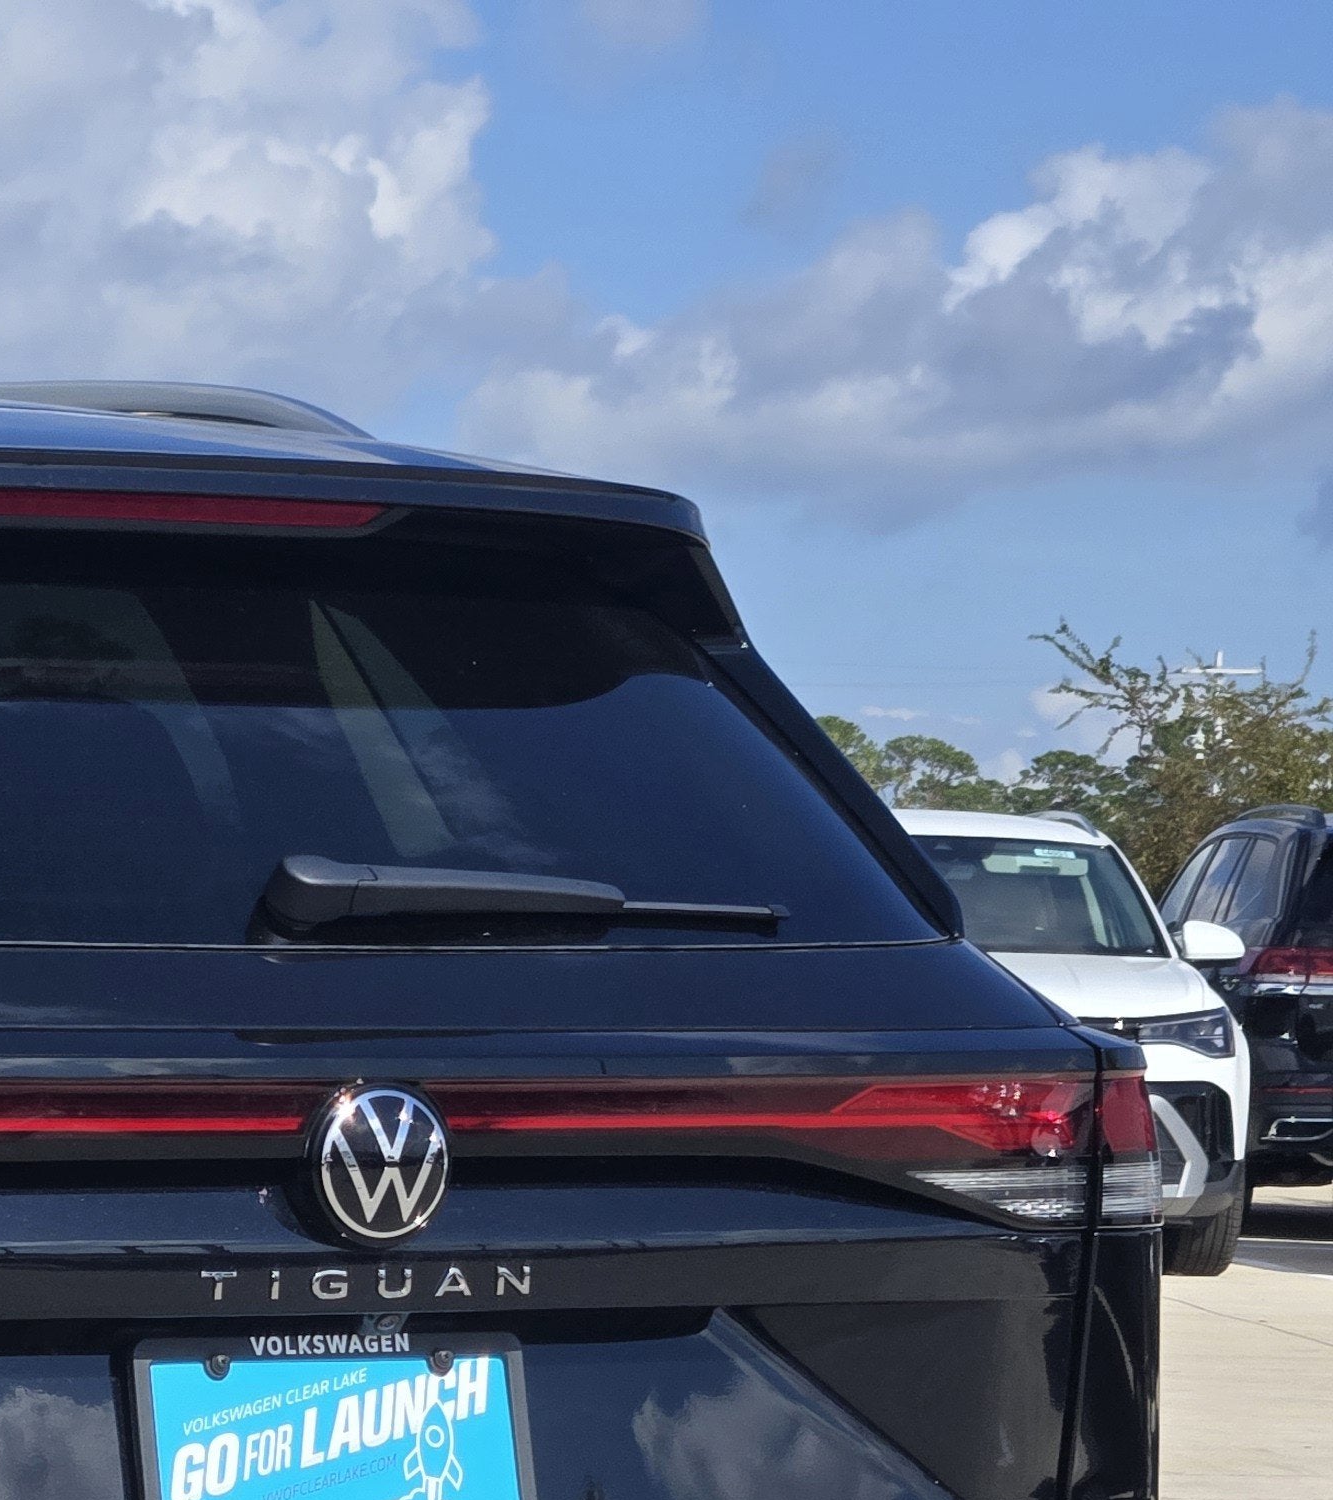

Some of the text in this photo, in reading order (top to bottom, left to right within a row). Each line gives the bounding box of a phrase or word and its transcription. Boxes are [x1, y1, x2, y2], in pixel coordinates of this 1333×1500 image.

[325, 1090, 446, 1232] VW
[200, 1265, 531, 1301] TIGUAN
[250, 1333, 410, 1356] VOLKSWAGEN
[183, 1368, 368, 1438] VOLKSWAGEN CLEAR LAKE
[243, 1423, 293, 1482] FOR
[300, 1357, 490, 1470] LAUNCH
